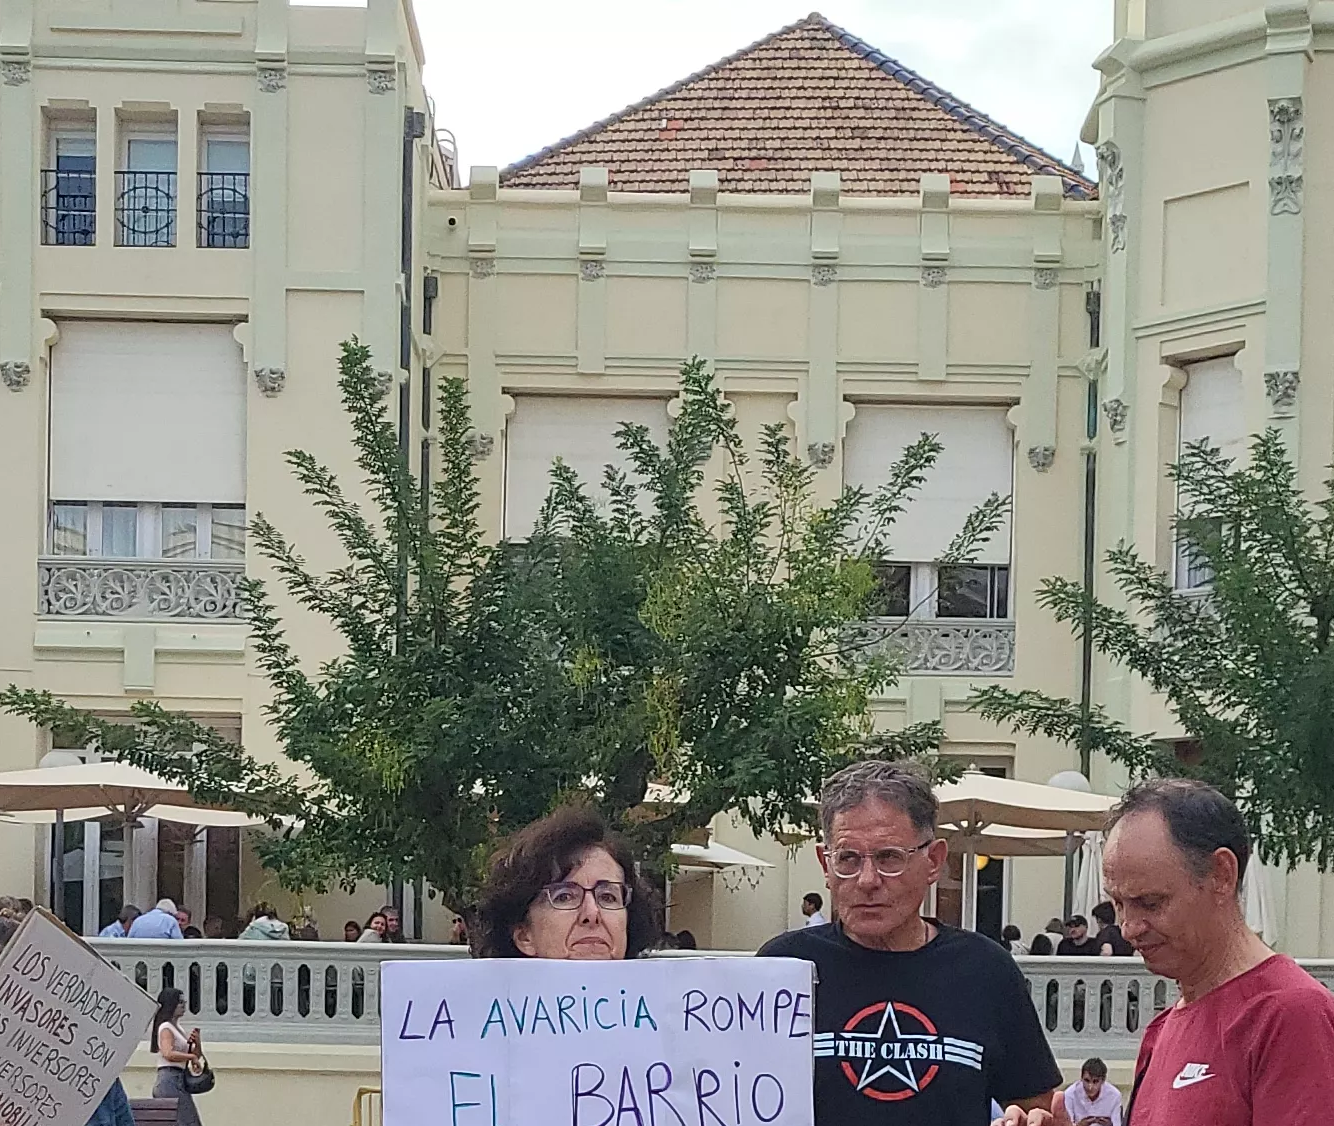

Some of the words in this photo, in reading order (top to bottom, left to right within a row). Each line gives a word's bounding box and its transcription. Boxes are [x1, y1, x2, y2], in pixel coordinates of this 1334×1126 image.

[12, 943, 51, 983] LOS
[46, 963, 131, 1037] VERDADEROS
[398, 997, 455, 1040] LA
[480, 986, 658, 1039] AVARICIA
[682, 988, 812, 1038] ROMPE
[7, 1027, 101, 1105] INVERSORES,
[83, 1036, 116, 1068] SON
[835, 1040, 876, 1058] THE
[880, 1042, 943, 1060] CLASH
